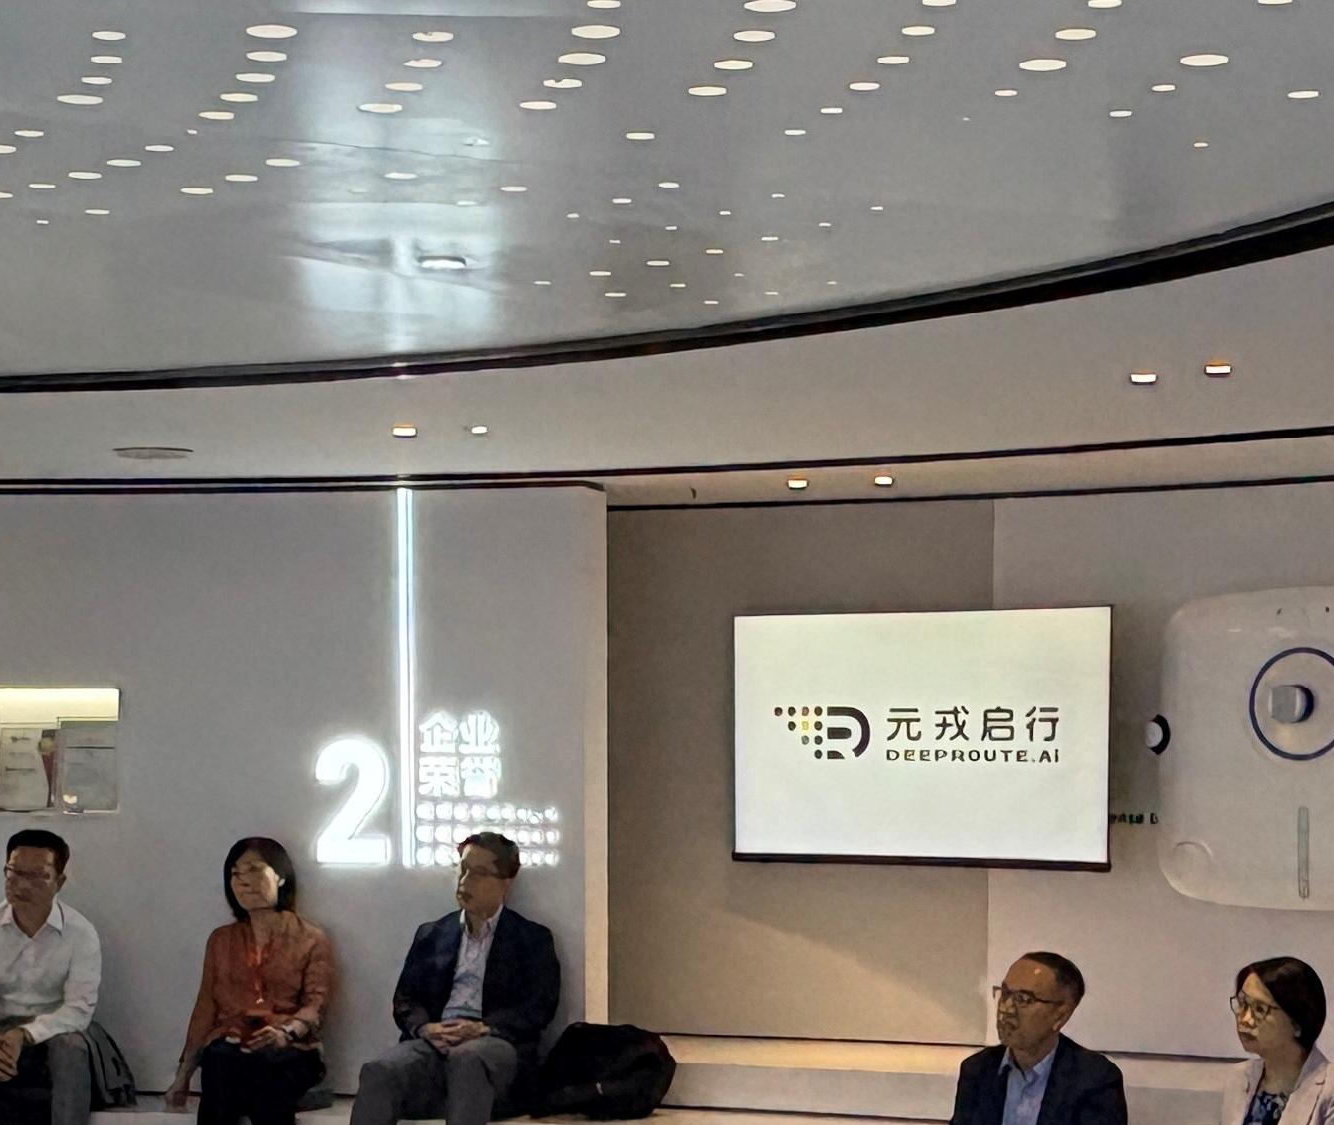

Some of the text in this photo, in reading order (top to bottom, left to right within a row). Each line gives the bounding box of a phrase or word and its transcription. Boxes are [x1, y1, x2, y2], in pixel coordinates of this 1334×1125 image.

[418, 709, 501, 754] 企业
[886, 705, 1060, 743] 元戎启行
[314, 737, 392, 868] 2
